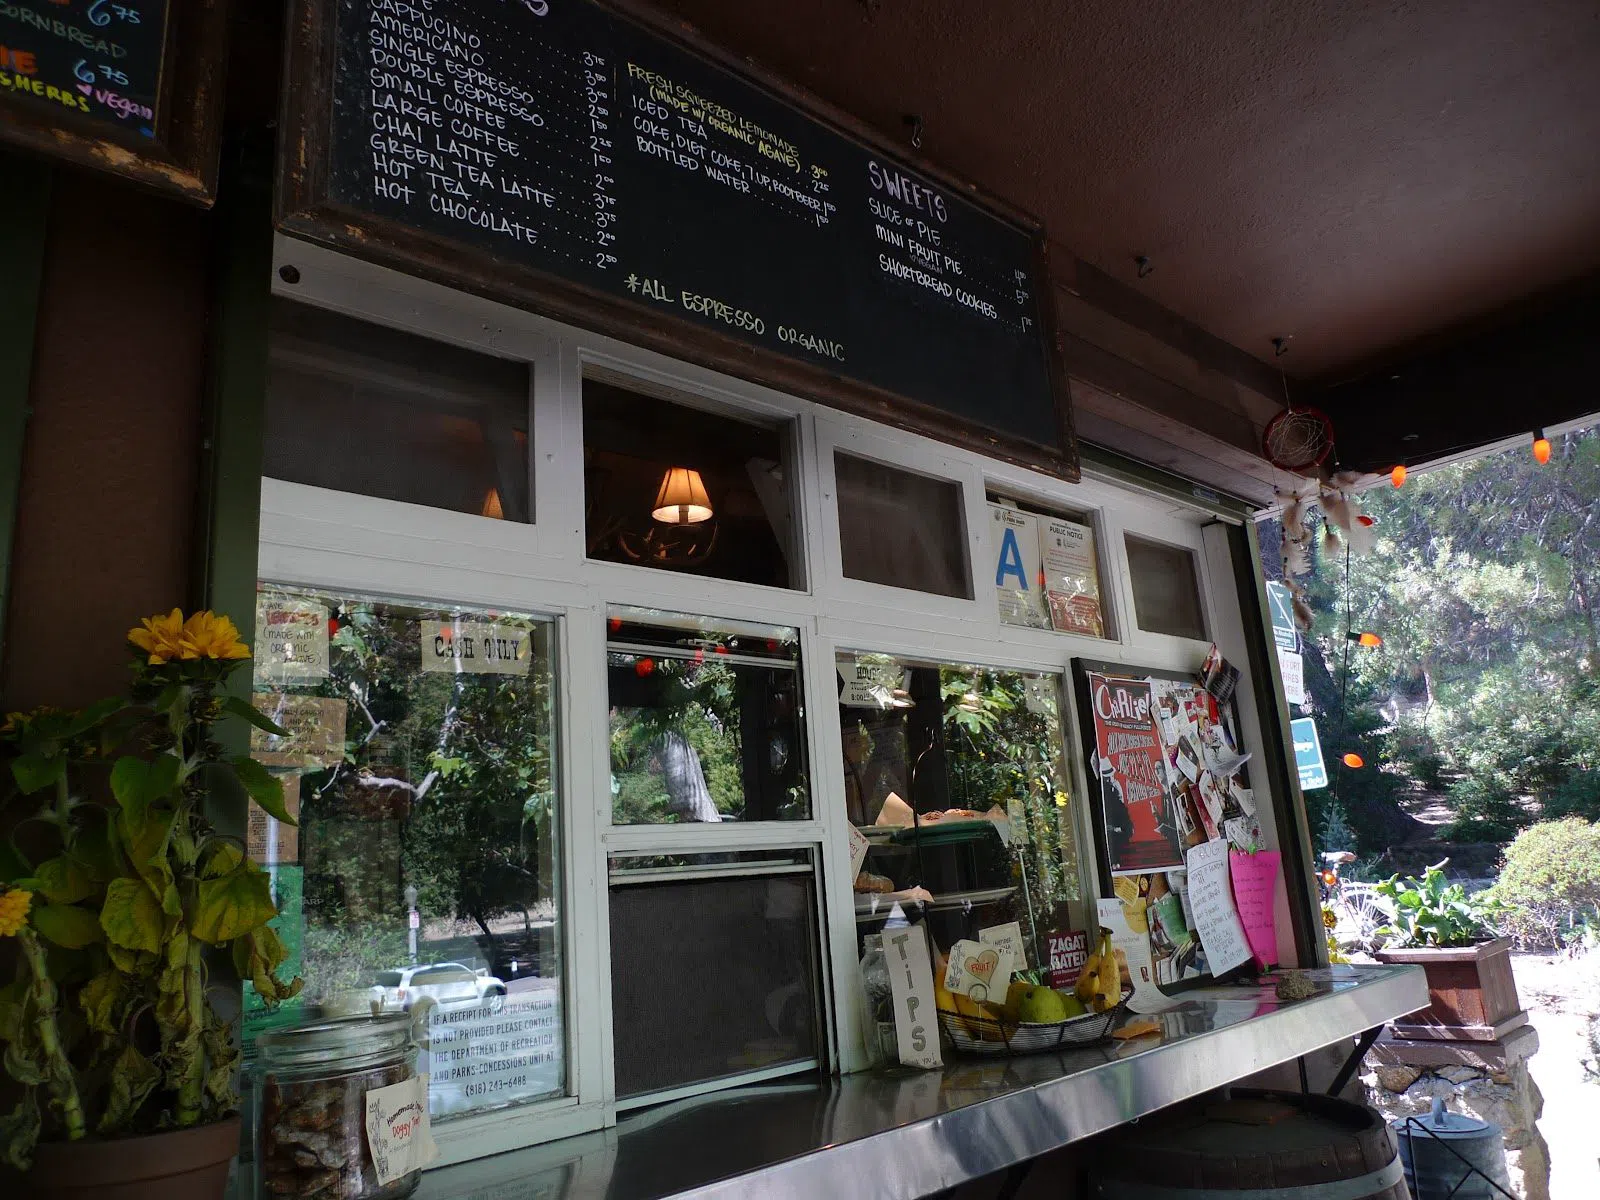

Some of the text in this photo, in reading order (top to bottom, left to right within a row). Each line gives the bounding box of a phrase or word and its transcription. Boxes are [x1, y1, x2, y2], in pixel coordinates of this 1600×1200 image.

[371, 11, 484, 66] AMERICANO
[370, 30, 436, 64] SINGLE
[446, 60, 534, 104] ESPRESSO
[371, 50, 446, 86] DOUBLE
[455, 80, 544, 126] ESPRESSO
[370, 68, 436, 104] SMALL
[444, 95, 506, 129] COFFEE
[372, 90, 443, 128] LARGE
[451, 119, 520, 156] COFFEE
[628, 62, 799, 157] FRESH SQUEEZED LEMONADE
[633, 95, 668, 120] ICED
[678, 116, 708, 140] TEA
[373, 112, 422, 143] CHAI
[436, 135, 496, 168] LATTE
[650, 86, 689, 112] (MADE
[708, 116, 756, 146] ORGANIC
[758, 142, 801, 173] AGAVE)
[676, 134, 706, 160] DIET
[370, 134, 444, 170] GREEN
[452, 162, 494, 189] TEA
[501, 177, 556, 208] LATTE
[374, 152, 415, 179] HOT
[426, 172, 472, 200] TEA
[637, 136, 698, 170] BOTTLED
[705, 165, 750, 194] WATER
[869, 160, 947, 222] SWEETS
[374, 176, 416, 204] HOT
[430, 194, 538, 244] CHOCOLATE
[869, 198, 902, 225] SLICE
[917, 221, 940, 246] PIE
[876, 224, 904, 248] MINI
[908, 239, 940, 266] FRUIT
[944, 256, 962, 274] PIE
[880, 254, 952, 298] SHORTBREAD
[956, 288, 997, 319] COOKIES
[682, 291, 764, 334] ESPRESSO
[778, 326, 844, 361] ORGANIC
[1050, 526, 1066, 536] PUBLIC
[996, 528, 1029, 591] A
[1049, 935, 1085, 954] ZAGAT
[1050, 952, 1087, 972] RATED
[434, 1000, 552, 1025] IF A RECEIPT FOR HIS TRANSACTION
[434, 1017, 552, 1044] IS NOT PROVIDED PLEASE CONTACT
[434, 1071, 448, 1082] AND
[530, 1054, 544, 1064] UNIT
[547, 1051, 554, 1062] AT
[436, 1034, 552, 1062] THE DEPARTMENT OF RECREATION
[466, 1084, 486, 1097] (818)
